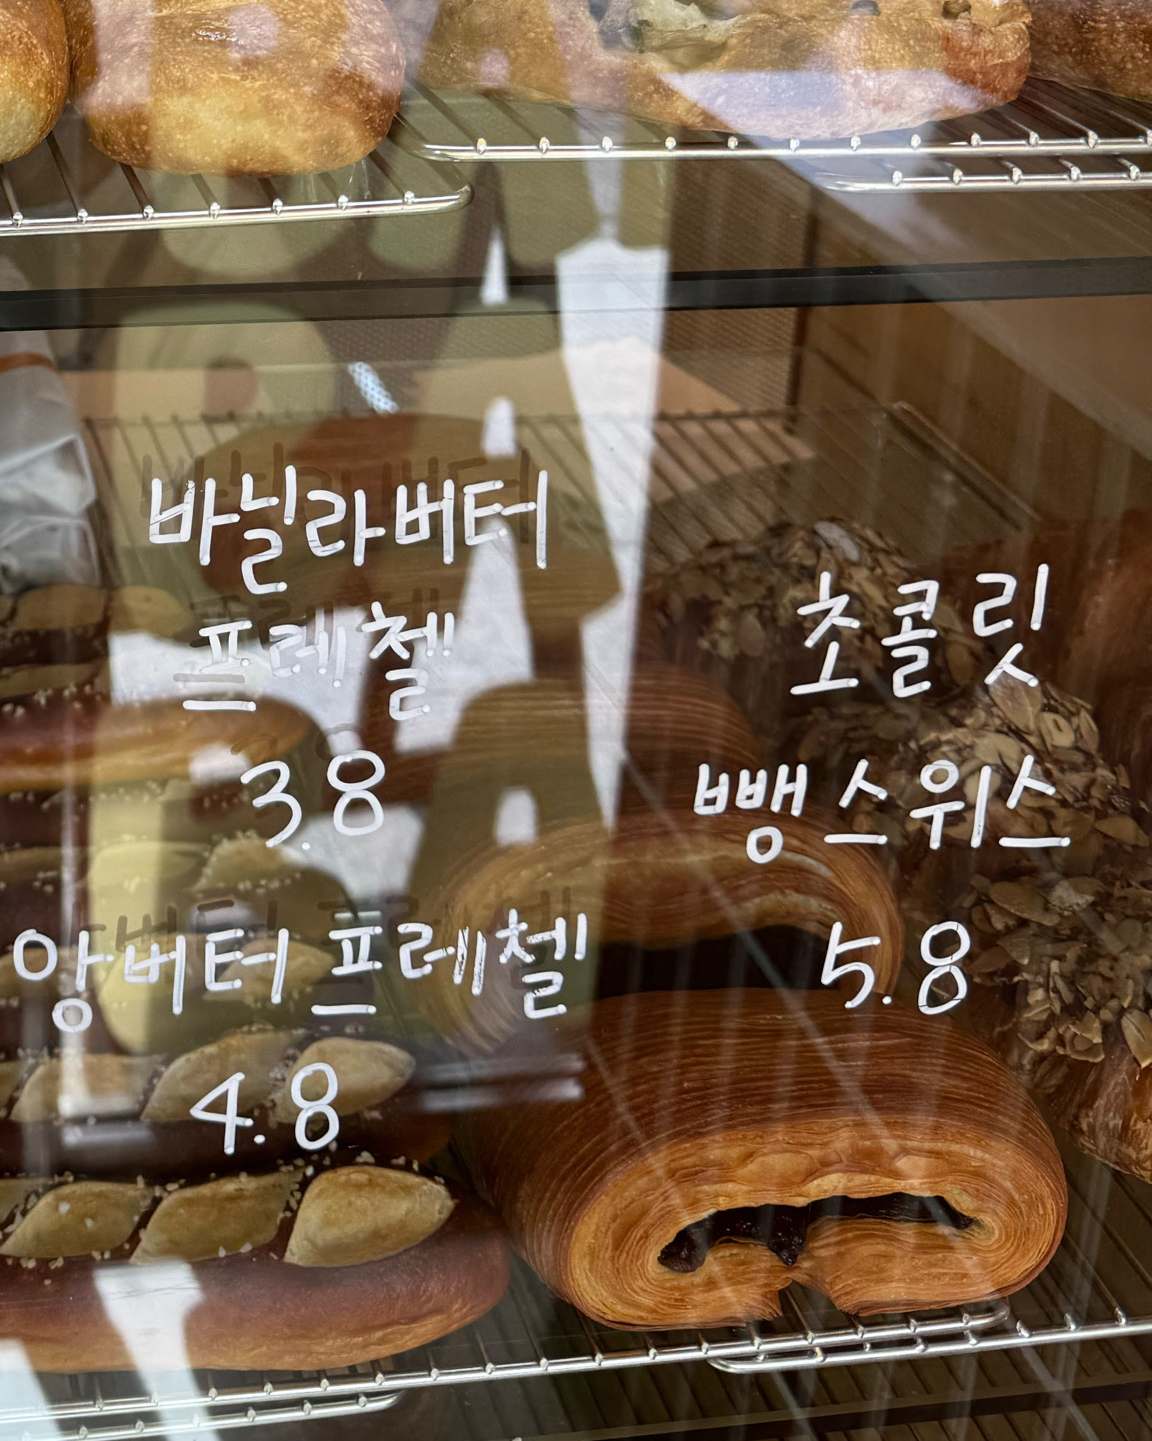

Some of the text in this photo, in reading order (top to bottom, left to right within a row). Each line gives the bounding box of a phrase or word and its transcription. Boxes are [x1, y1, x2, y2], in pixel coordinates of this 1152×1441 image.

[150, 465, 548, 595] 바닐라버터
[182, 601, 456, 721] 프레첼
[789, 563, 1050, 698] 초콜릿
[241, 750, 387, 849] 3.8
[12, 909, 589, 1034] 앙버터 프레첼
[820, 921, 971, 1015] 5.8
[189, 1062, 341, 1156] 4.8
